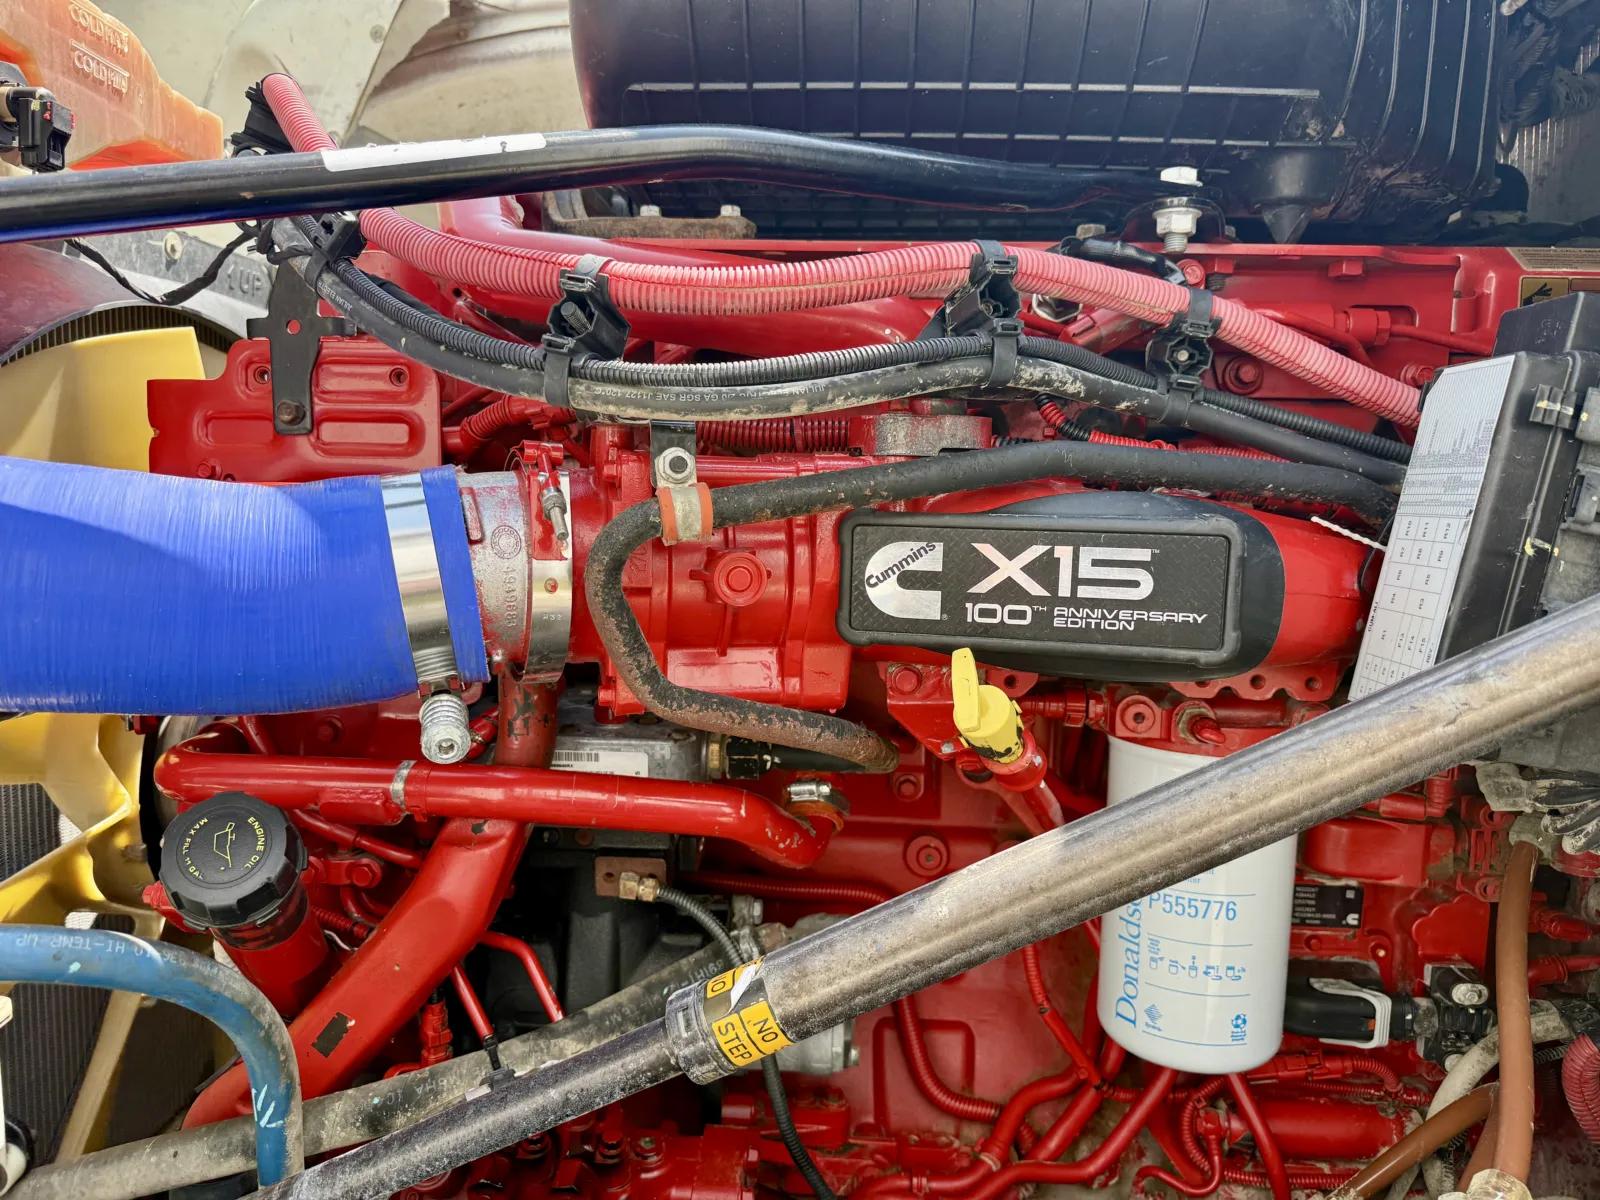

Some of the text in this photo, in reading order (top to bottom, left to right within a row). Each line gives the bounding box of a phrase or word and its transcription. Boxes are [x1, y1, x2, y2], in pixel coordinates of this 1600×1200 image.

[74, 48, 106, 83] COLD
[655, 392, 677, 401] SAE
[679, 393, 701, 402] SGR
[703, 393, 719, 402] GA
[865, 541, 1155, 601] Cummins X15
[1053, 606, 1209, 625] ANNIVERSARY
[1053, 617, 1136, 632] EDITION
[188, 816, 209, 836] MAX
[182, 837, 192, 855] FILL
[243, 816, 265, 870] ENGINE OIL
[1148, 892, 1238, 921] P555776
[753, 1017, 779, 1044] NO
[718, 1021, 753, 1061] STEP
